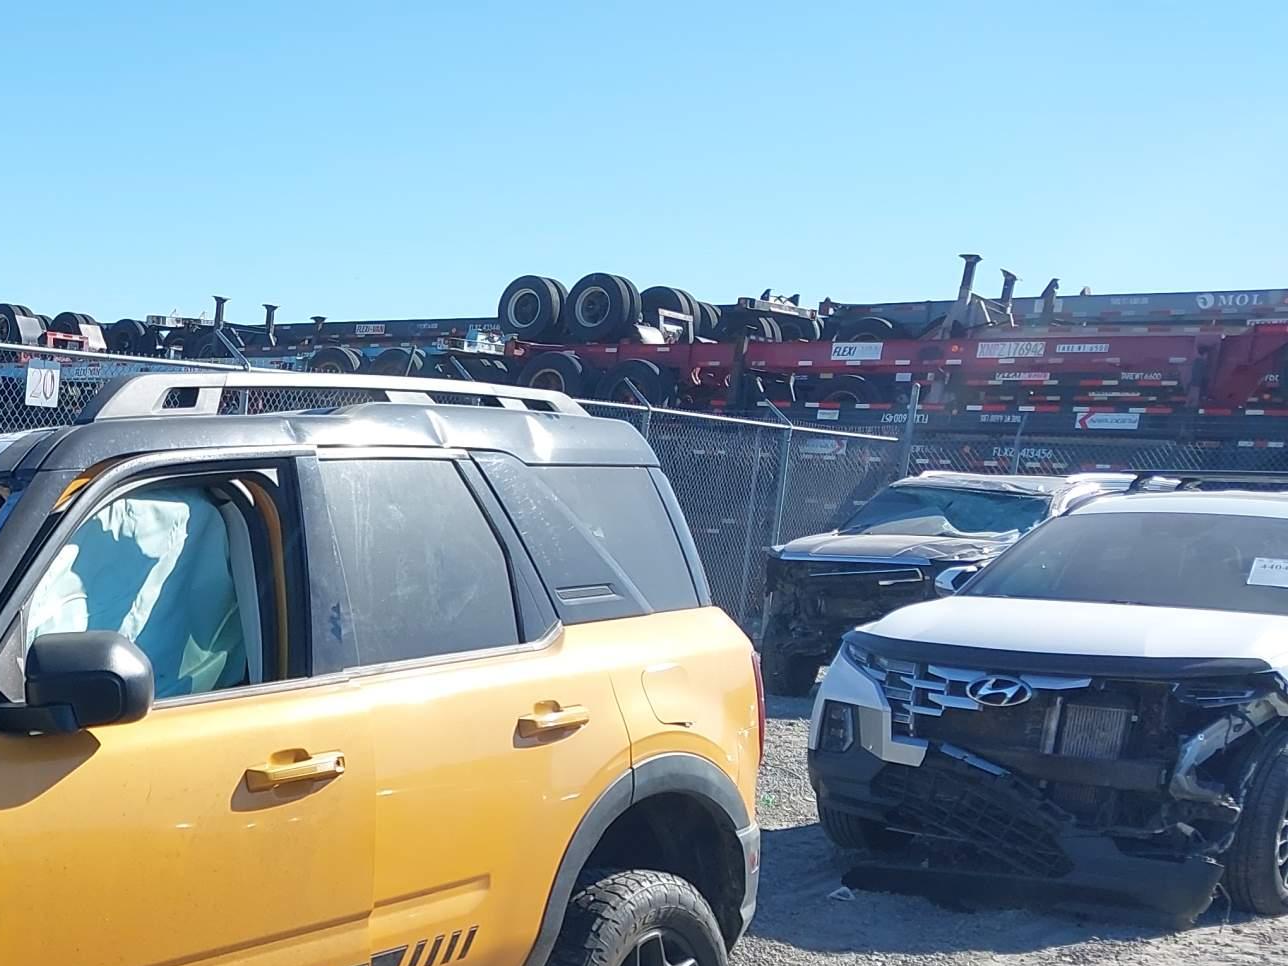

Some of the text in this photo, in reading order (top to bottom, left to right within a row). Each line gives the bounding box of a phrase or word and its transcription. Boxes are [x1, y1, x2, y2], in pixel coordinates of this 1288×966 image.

[1217, 293, 1263, 306] MOL
[832, 346, 857, 357] FLEXI
[29, 368, 55, 401] 20
